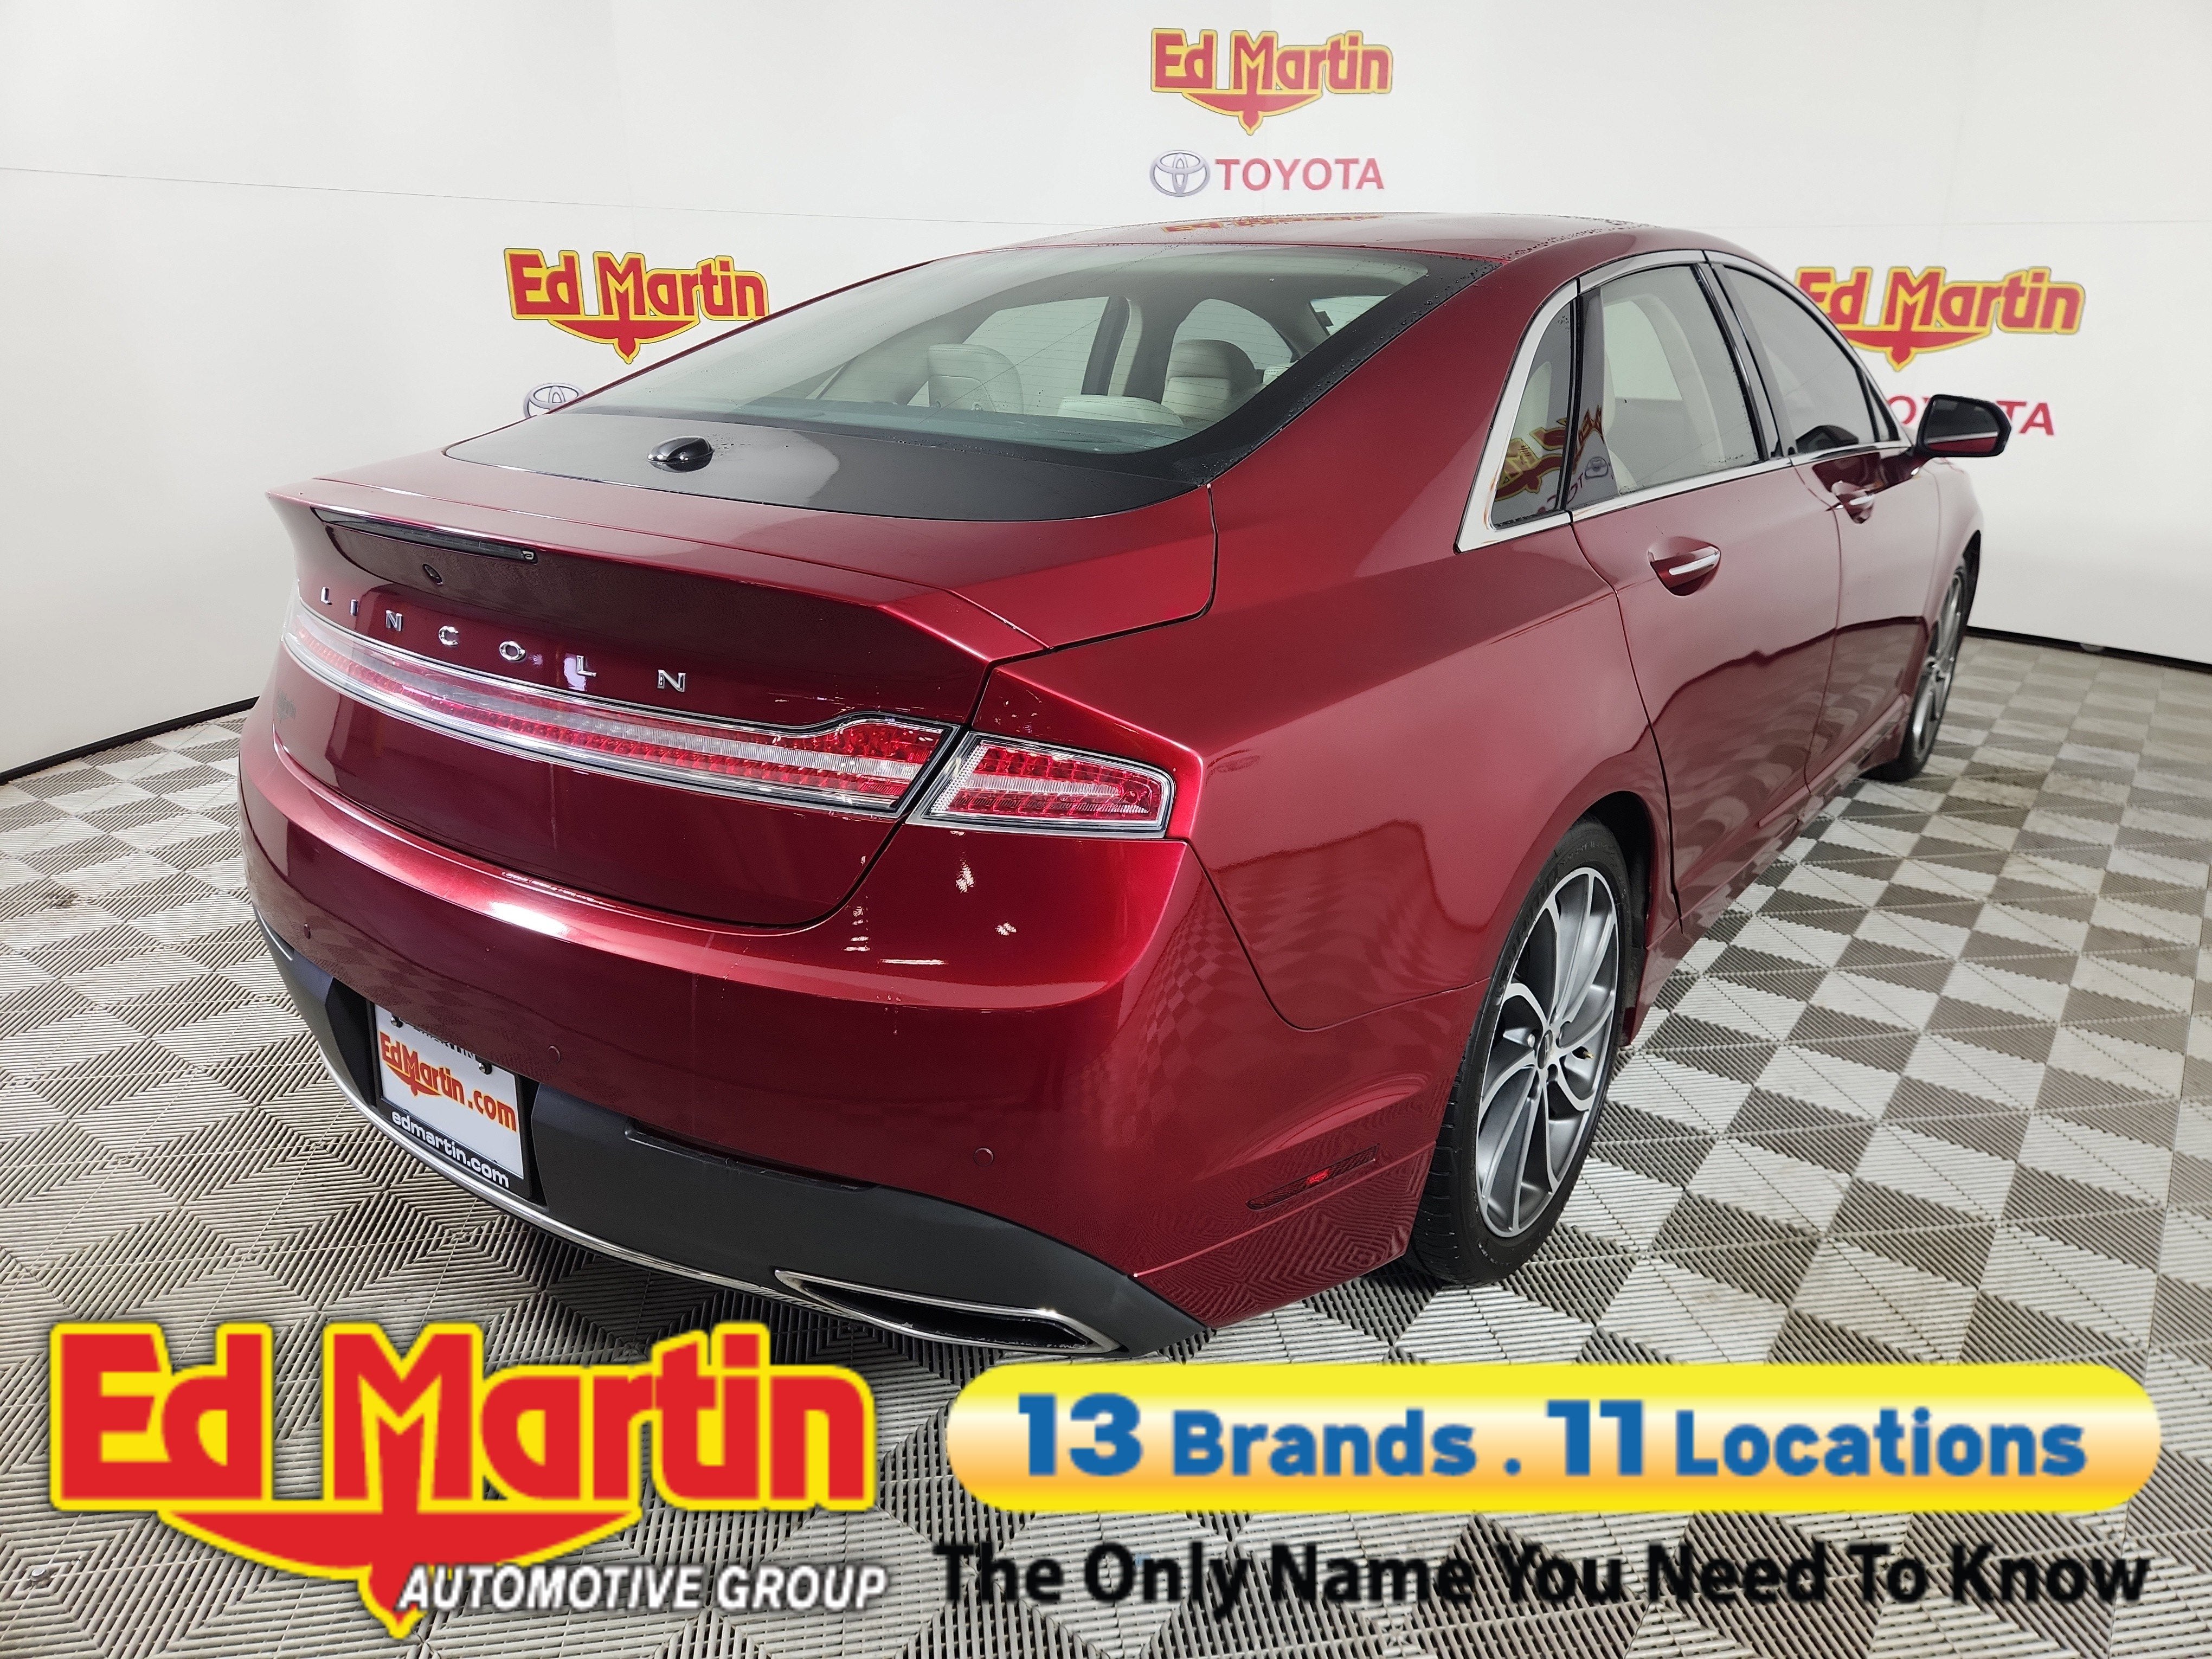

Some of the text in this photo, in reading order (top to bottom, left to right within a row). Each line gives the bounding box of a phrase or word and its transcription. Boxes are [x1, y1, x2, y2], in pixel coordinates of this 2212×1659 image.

[1153, 30, 1391, 92] Ed Martin
[1215, 157, 1385, 191] TOYOTA
[506, 251, 767, 318] Ed Martin
[1883, 268, 2084, 331] Martin
[320, 586, 687, 694] LINCOLN
[379, 1030, 517, 1133] EdMartin.com
[391, 1110, 510, 1188] edmartin.com
